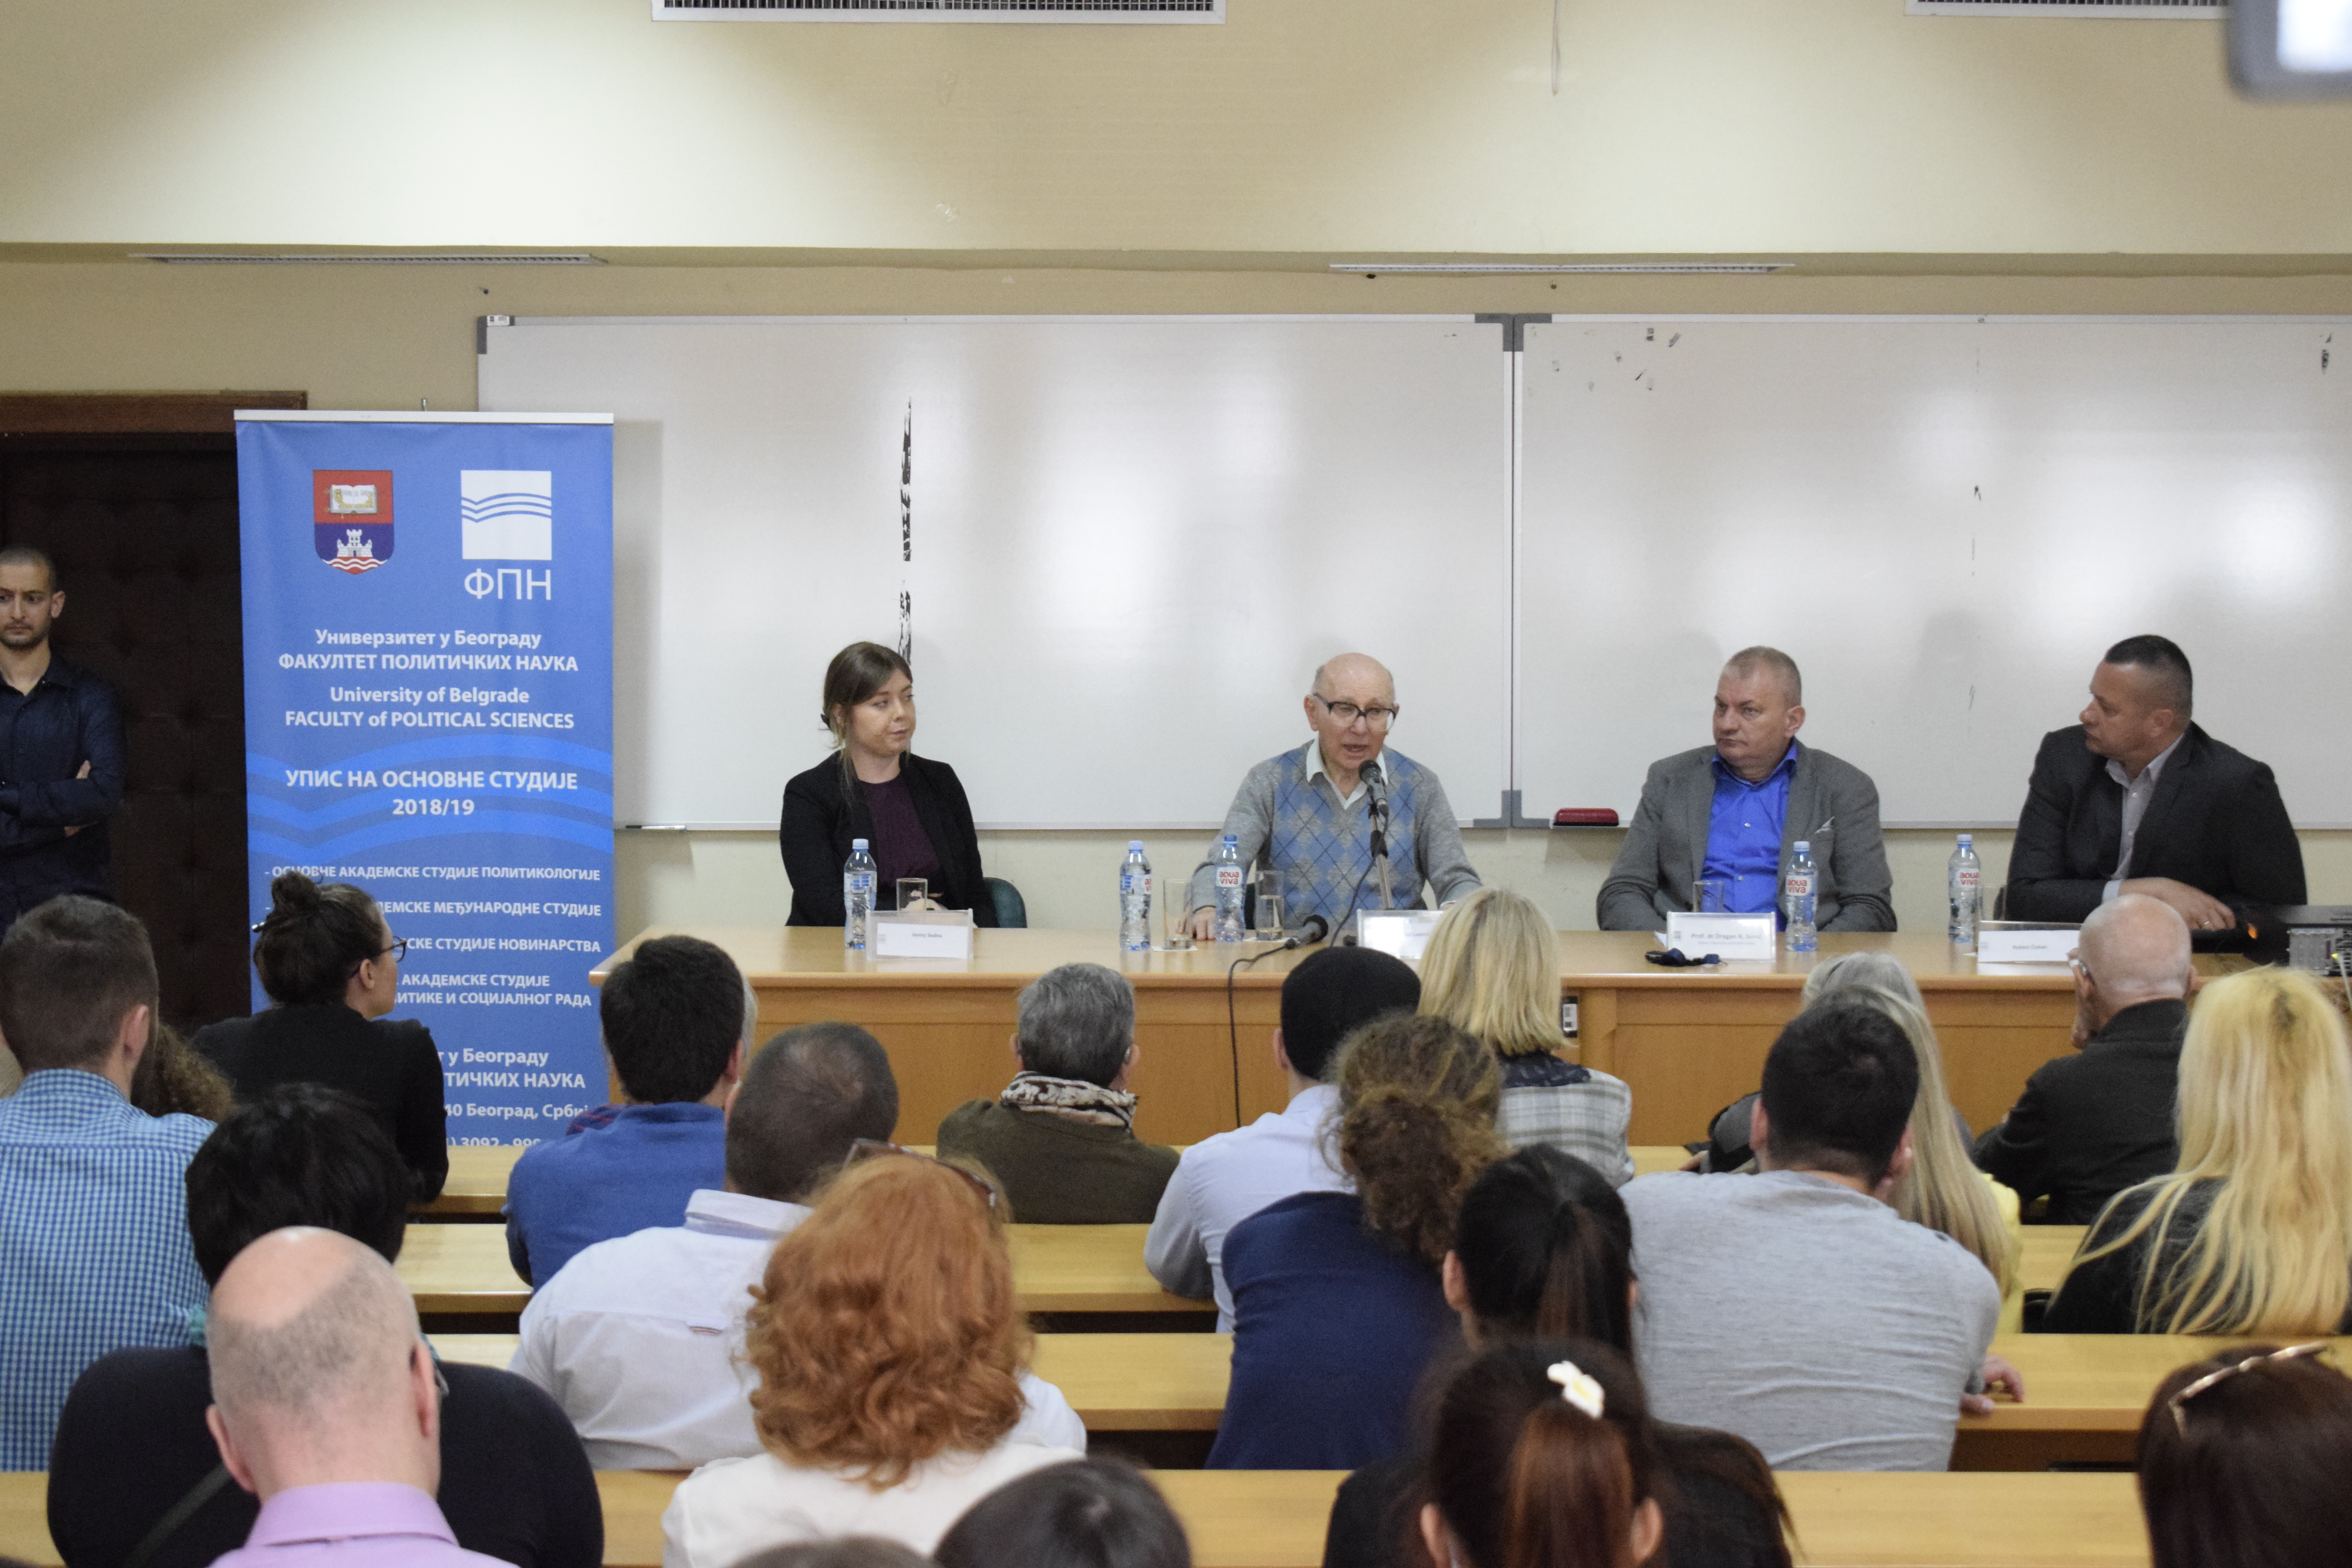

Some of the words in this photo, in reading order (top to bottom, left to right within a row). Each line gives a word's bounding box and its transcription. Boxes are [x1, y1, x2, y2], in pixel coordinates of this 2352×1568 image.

[464, 568, 551, 601] ФПН
[315, 629, 436, 648] Универзитет
[439, 633, 449, 649] у
[454, 630, 542, 650] Београду
[279, 653, 377, 669] ФАКУЛТЕТ
[381, 654, 512, 670] ПОЛИТИЧКИХ
[516, 655, 579, 671] НАУКА
[330, 686, 423, 706] University
[426, 686, 446, 702] of
[449, 687, 530, 706] Belgrade
[286, 711, 364, 726] FACULTY
[368, 711, 388, 727] of
[391, 711, 486, 727] POLITICAL
[490, 711, 574, 729] SCIENCES
[285, 770, 343, 787] УПИС
[348, 771, 377, 787] НА
[382, 770, 485, 788] ОСНОВНЕ
[489, 771, 577, 792] СТУДИЈЕ
[392, 799, 475, 816] 2018/19
[339, 866, 419, 879] АКАДЕМСКЕ
[422, 867, 479, 880] СТУДИЈЕ
[481, 867, 600, 881] ПОЛИТИКОЛОГИЈЕ
[434, 902, 540, 916] МЕЂУНАРОДНЕ
[543, 902, 601, 917] СТУДИЈЕ
[435, 938, 496, 952] СТУДИЈЕ
[499, 938, 601, 953] НОВИНАРСТВА
[401, 974, 487, 988] АКАДЕМСКЕ
[490, 974, 550, 989] СТУДИЈЕ
[446, 993, 456, 1004] И
[459, 992, 552, 1006] СОЦИЈАЛНОГ
[555, 993, 592, 1008] РАДА
[448, 1052, 459, 1067] у
[463, 1048, 549, 1067] Београду
[445, 1072, 519, 1087] ТИЧКИХ
[524, 1073, 586, 1088] НАУКА
[466, 1103, 538, 1120] Београд,
